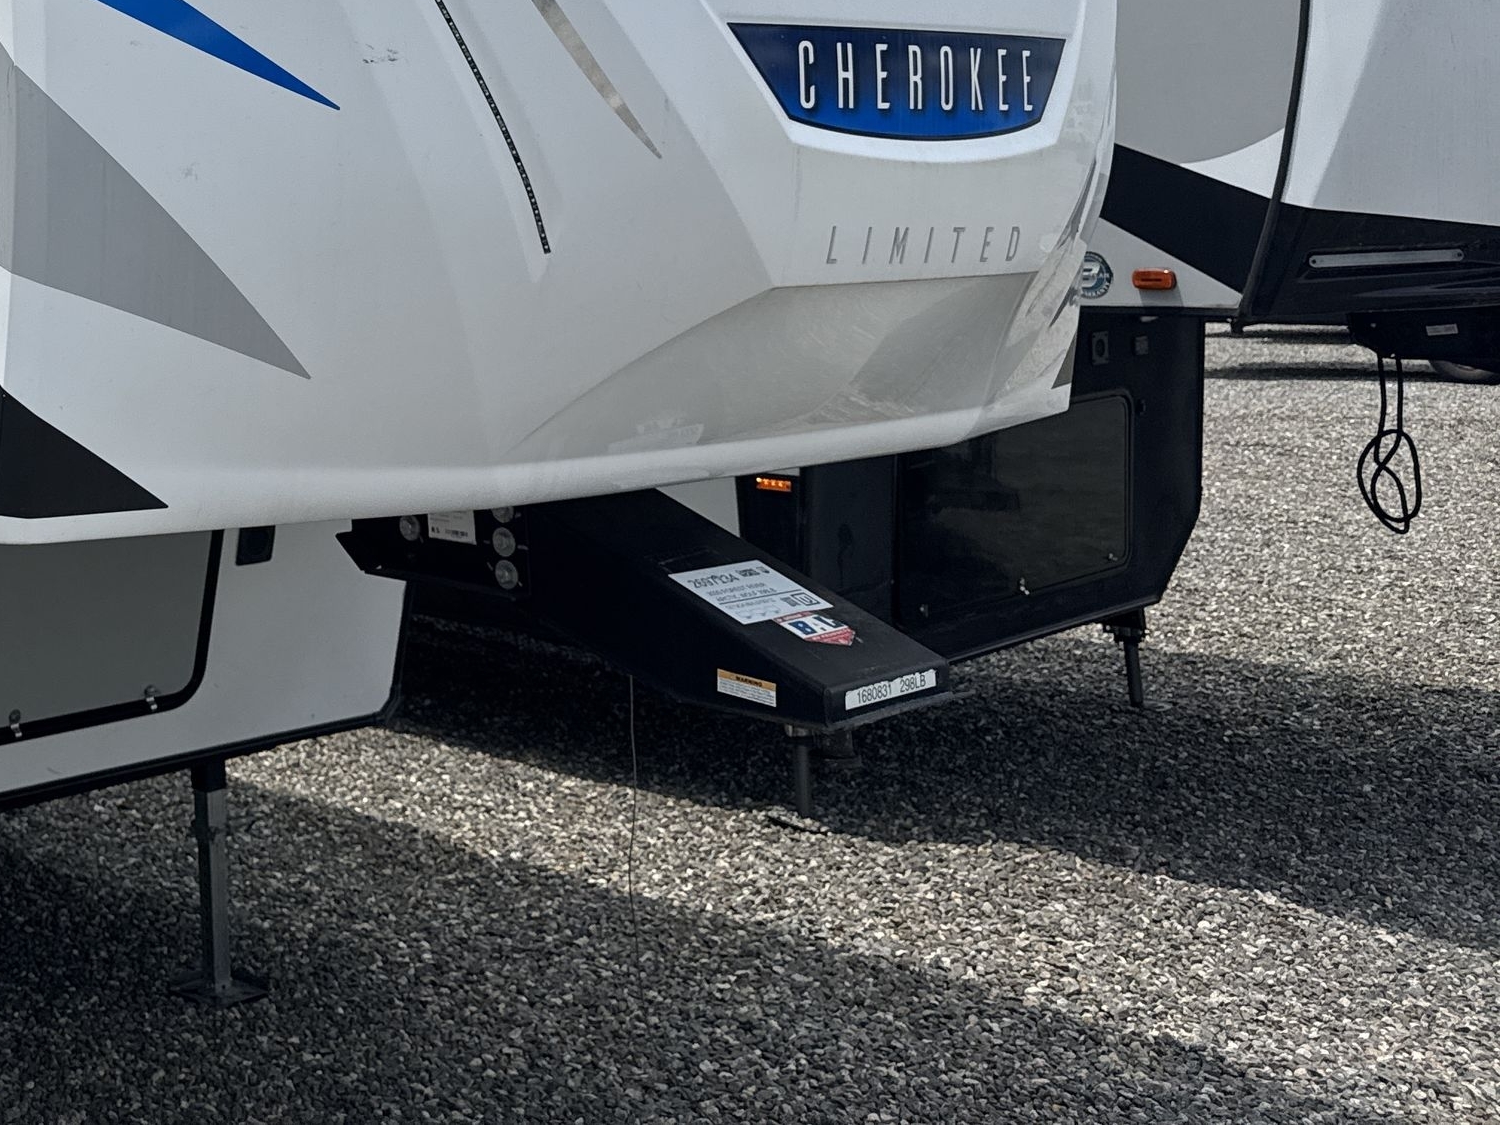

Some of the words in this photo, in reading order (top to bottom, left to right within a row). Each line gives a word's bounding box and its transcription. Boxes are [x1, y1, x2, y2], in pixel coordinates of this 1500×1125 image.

[797, 40, 1034, 112] CHEROKEE
[825, 225, 1022, 265] LIMITED
[857, 683, 892, 704] 1680831
[900, 674, 927, 693] 298LB
